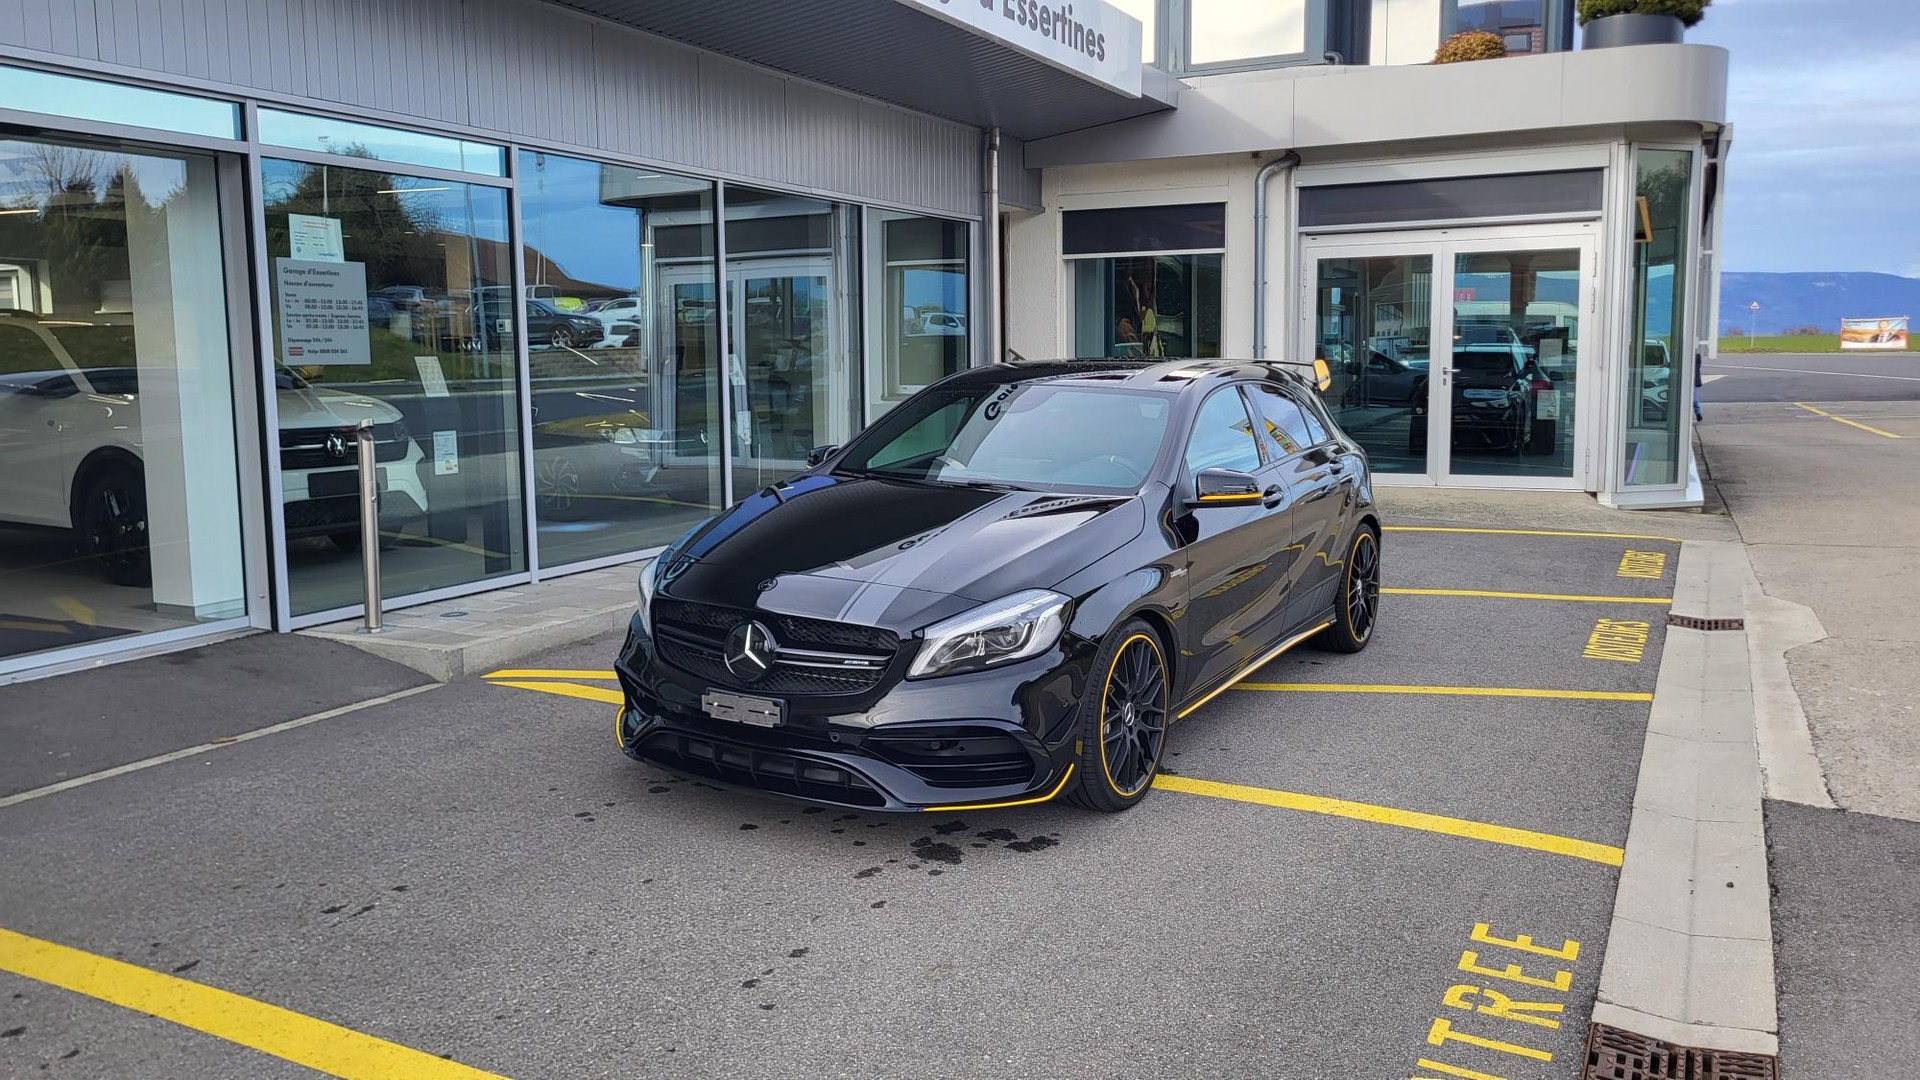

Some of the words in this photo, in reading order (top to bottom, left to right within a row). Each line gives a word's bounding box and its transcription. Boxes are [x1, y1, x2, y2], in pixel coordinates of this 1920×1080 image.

[980, 0, 1105, 62] Essertines
[283, 267, 306, 276] Garage
[1582, 619, 1650, 662] VISITEURS
